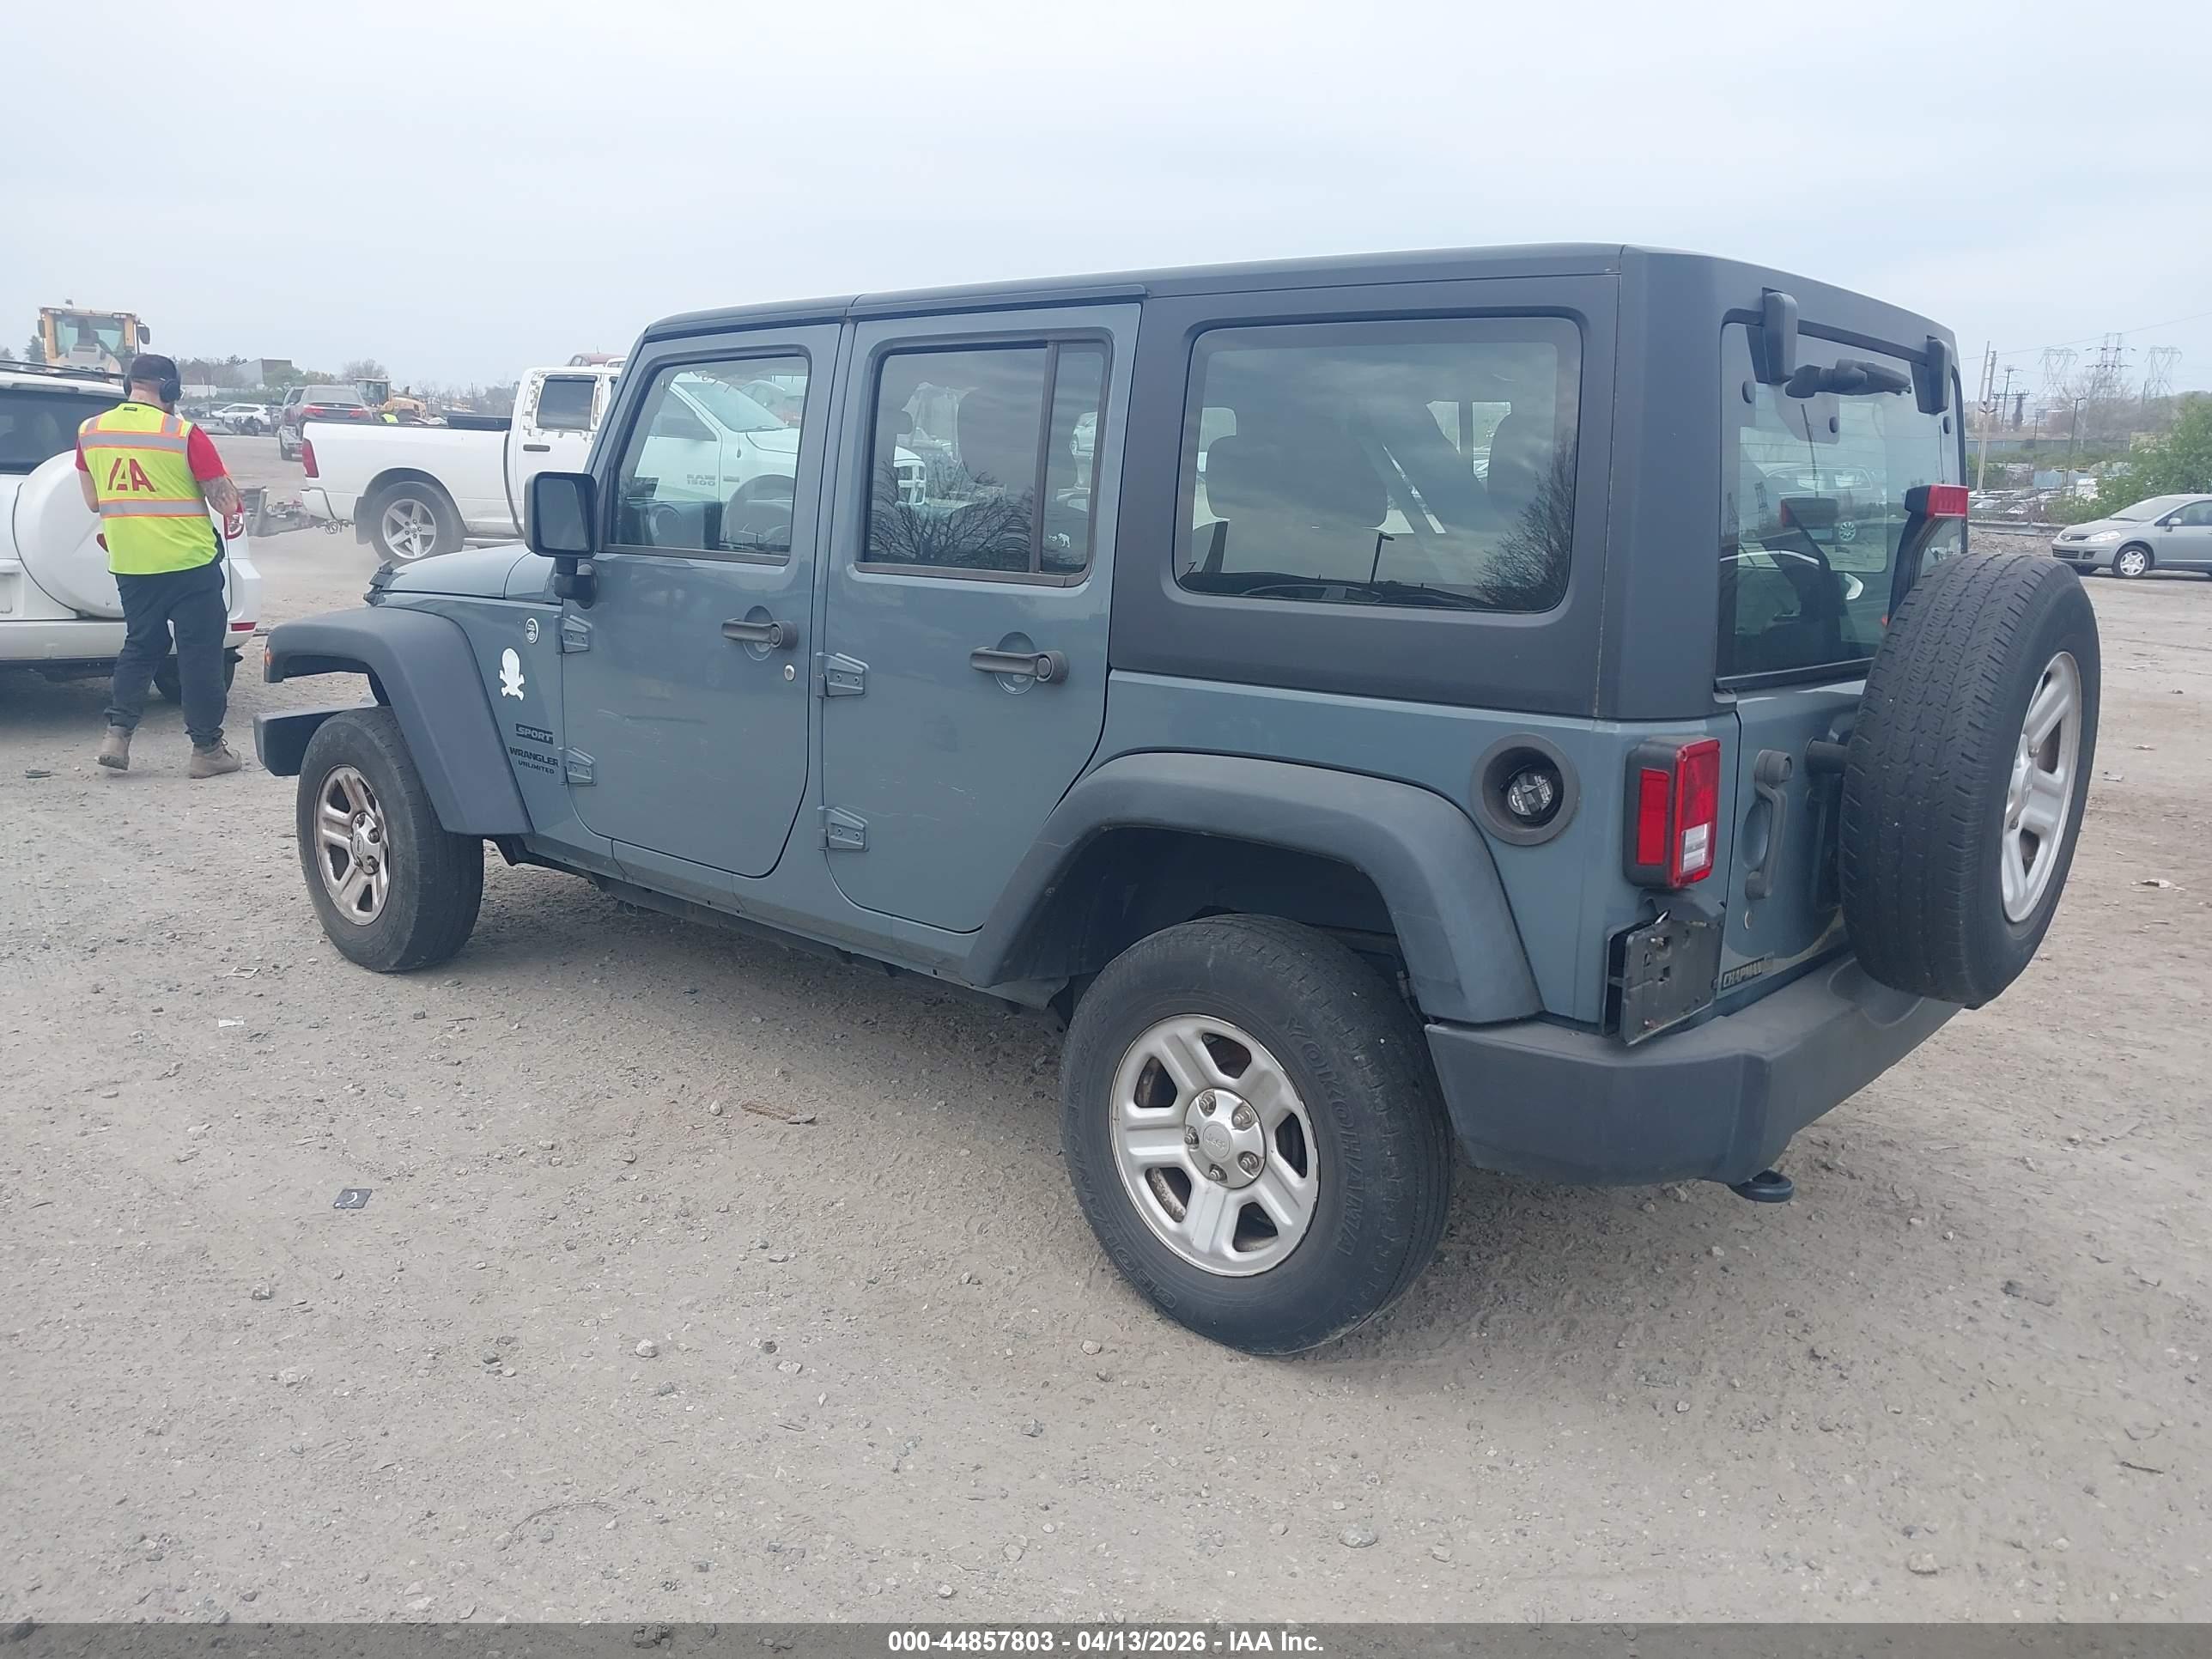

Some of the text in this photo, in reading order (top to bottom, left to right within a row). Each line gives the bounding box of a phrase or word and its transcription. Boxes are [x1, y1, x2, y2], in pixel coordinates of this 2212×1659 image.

[517, 726, 554, 743] SPORT
[509, 746, 559, 768] WRANGLER
[518, 760, 555, 774] UNLIMITED
[1288, 1017, 1364, 1255] YOKOHAMA
